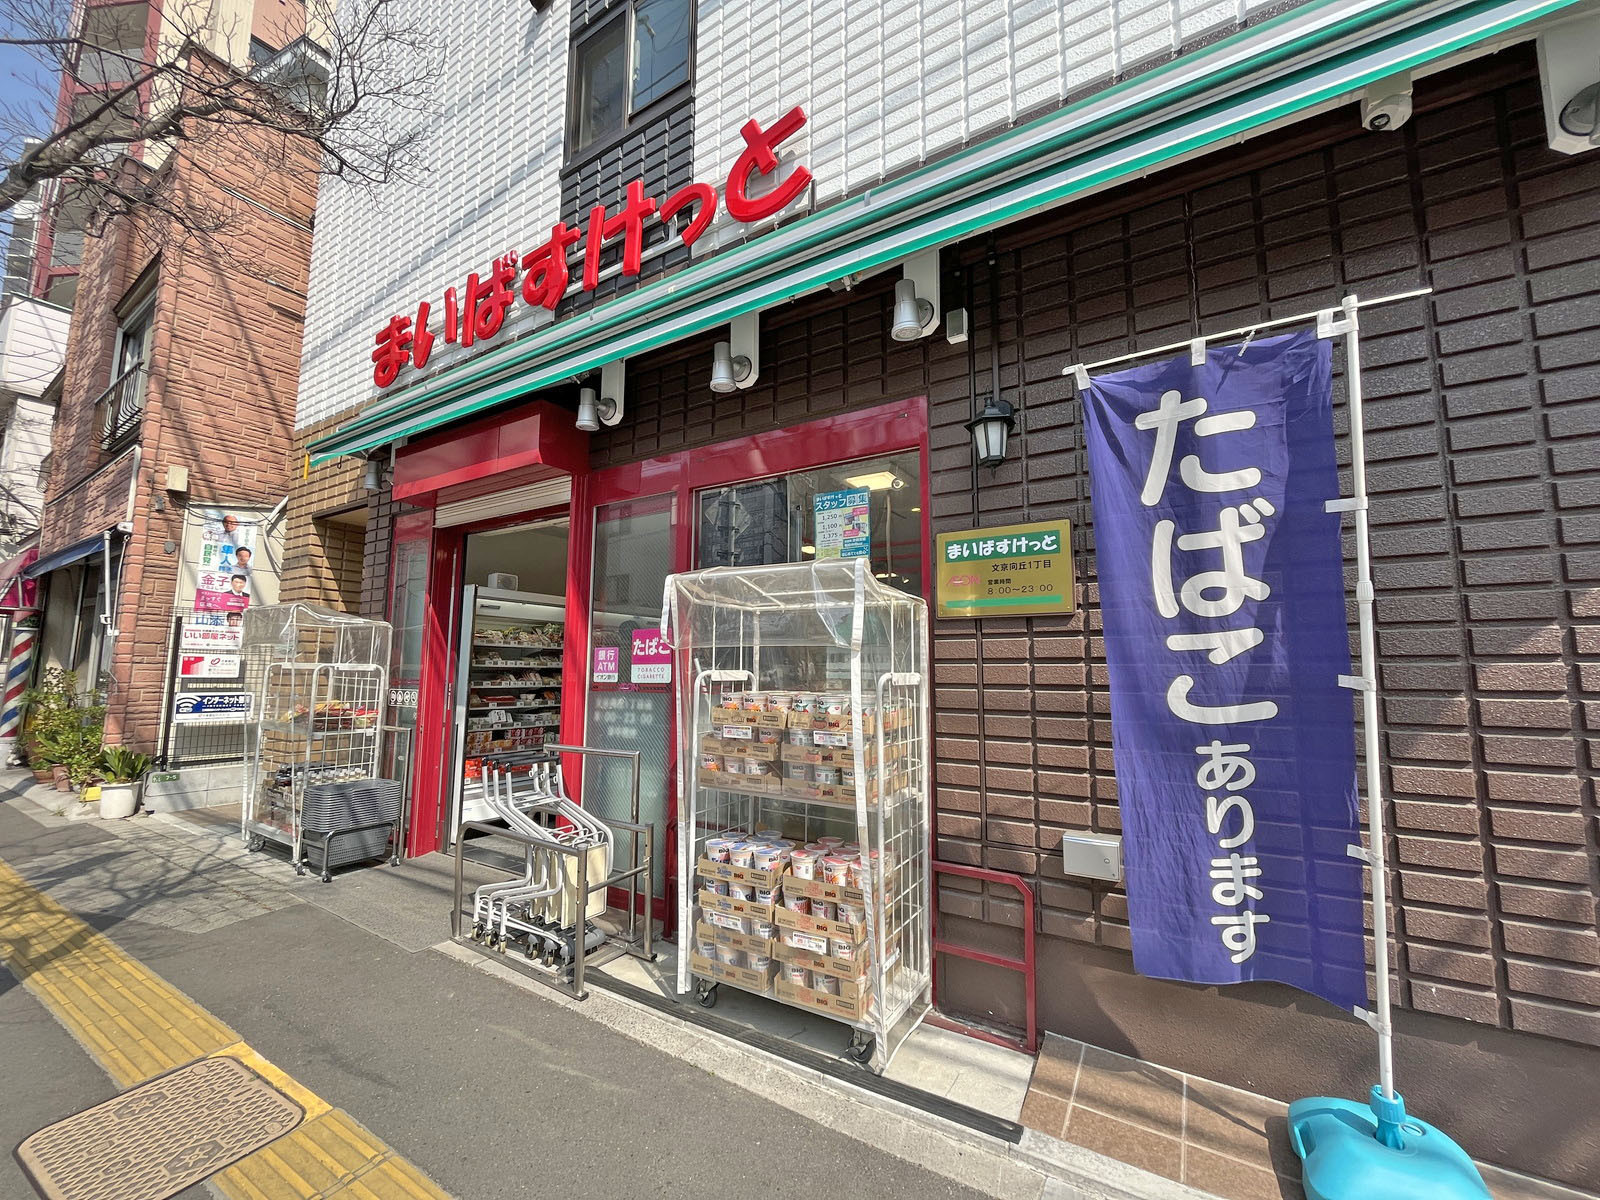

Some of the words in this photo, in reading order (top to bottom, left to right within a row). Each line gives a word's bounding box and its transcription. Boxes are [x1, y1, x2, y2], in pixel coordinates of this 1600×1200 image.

[372, 105, 813, 388] まいばすけっと
[947, 534, 1058, 560] まいばすけっと
[991, 559, 1052, 572] 文京向丘1丁目
[201, 574, 231, 587] 金子
[633, 637, 671, 656] たばこ
[597, 661, 615, 671] ATM
[1134, 389, 1279, 964] たばこあります
[824, 890, 837, 898] BIG
[816, 924, 828, 932] BIG
